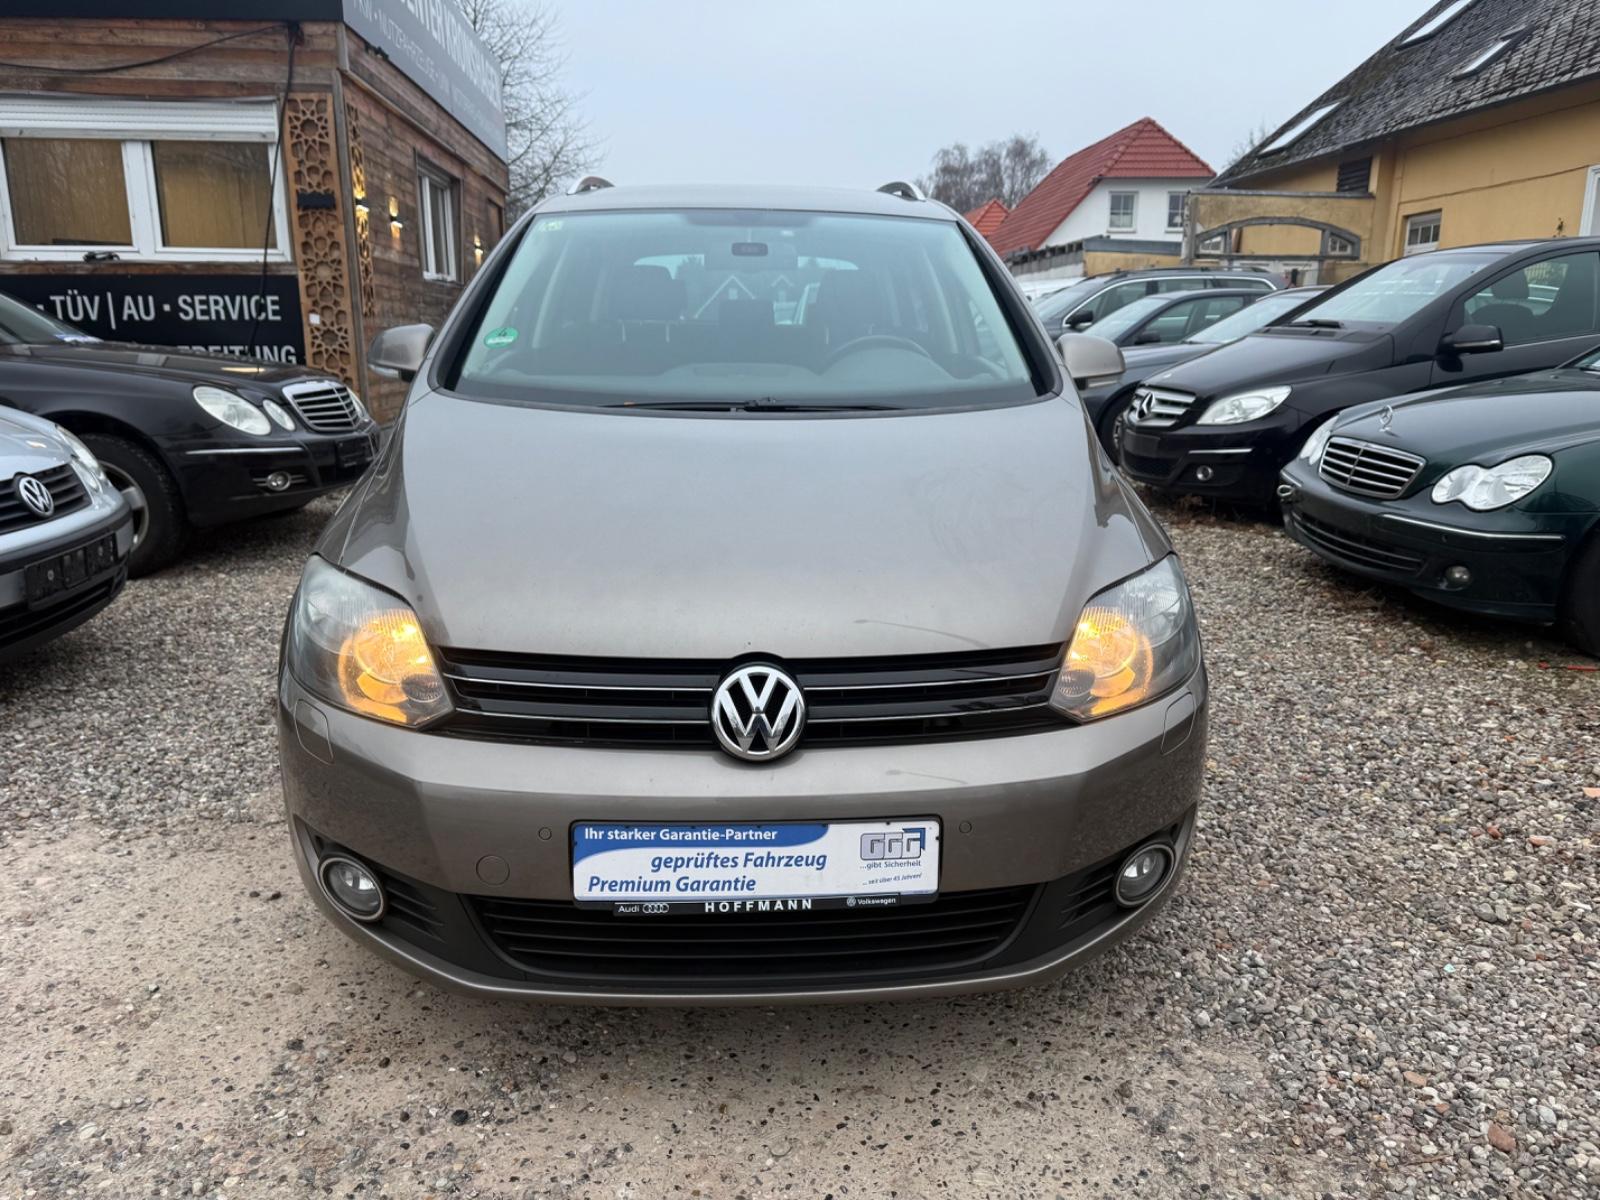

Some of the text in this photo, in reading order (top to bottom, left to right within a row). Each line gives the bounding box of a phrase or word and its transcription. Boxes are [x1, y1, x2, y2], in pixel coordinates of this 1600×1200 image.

[50, 290, 281, 321] TÜV AU SERVICE
[584, 827, 778, 841] Ihr starker Garantie-Partner
[651, 851, 827, 873] geprüftes Fahrzeug
[884, 860, 921, 868] Sicherheit
[588, 875, 756, 893] Premium Garantie
[618, 905, 640, 913] Audi
[704, 899, 812, 913] HOFFMANN
